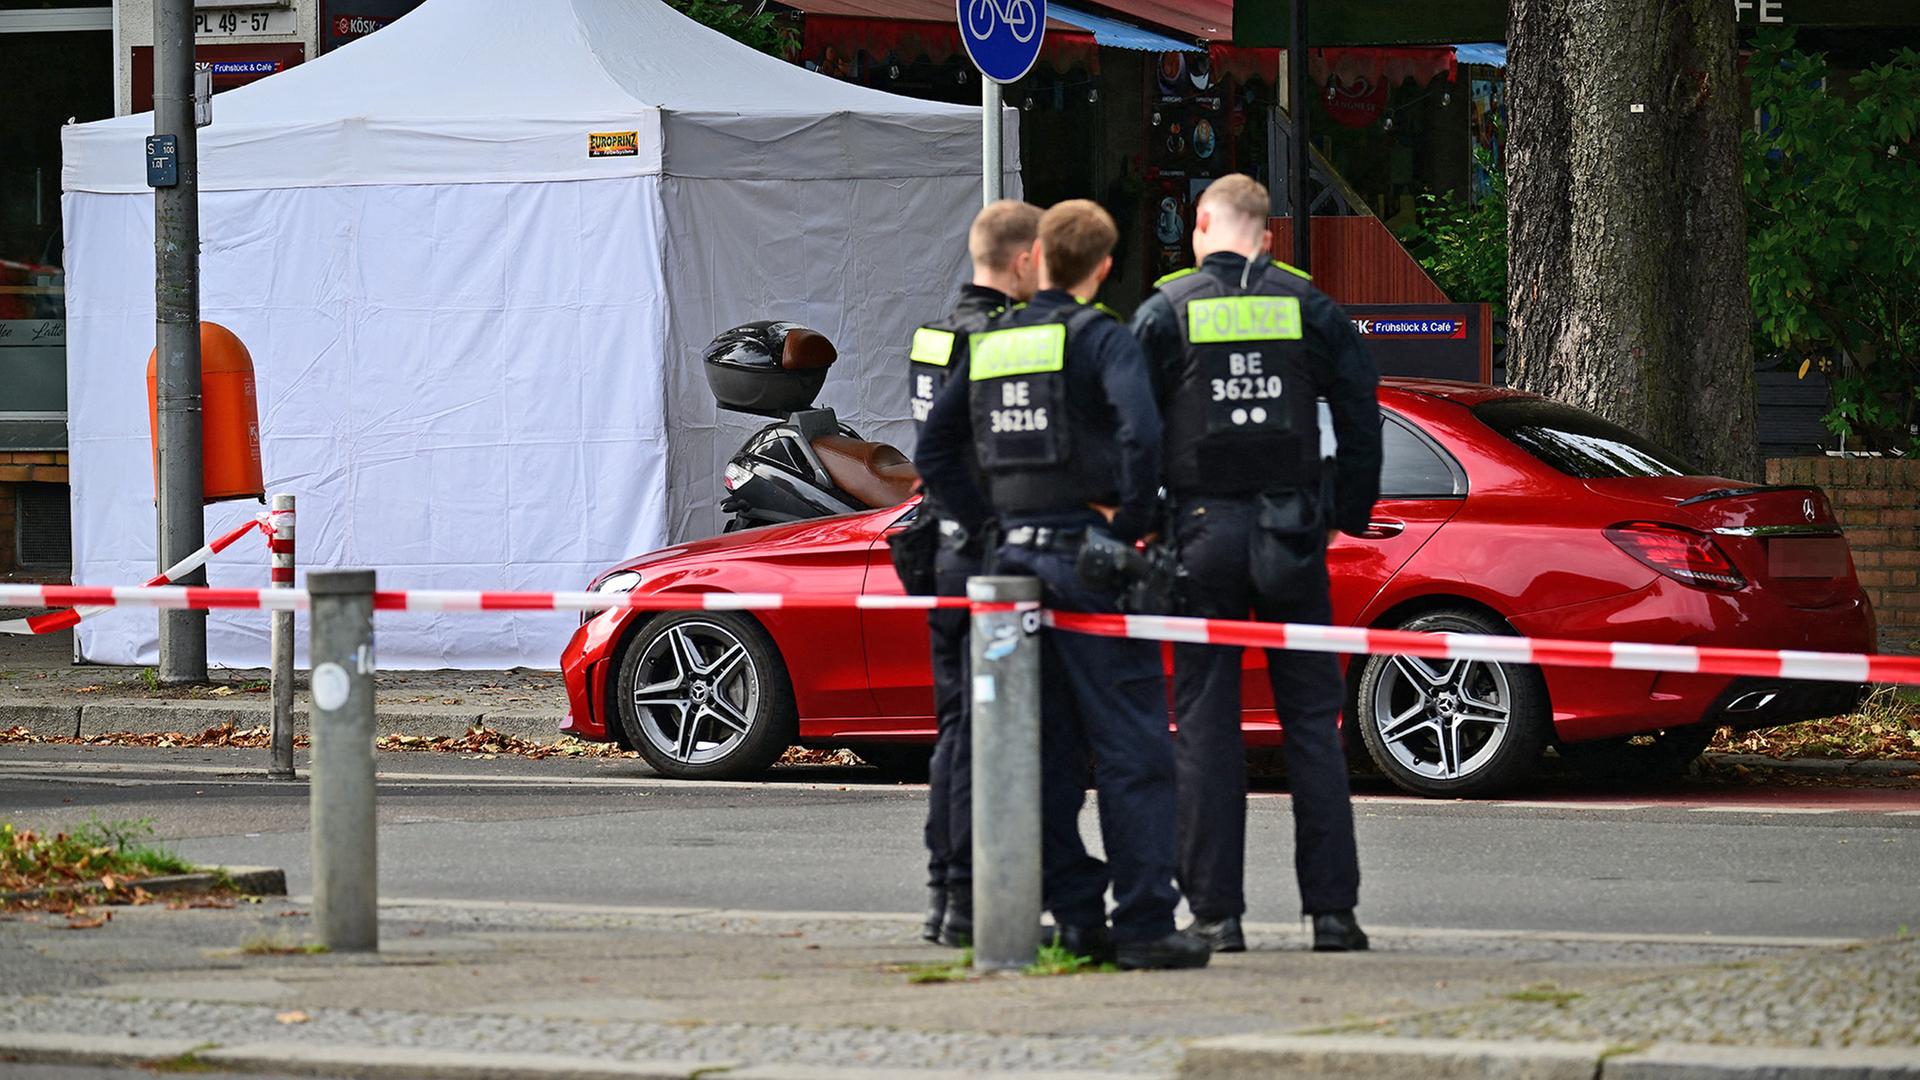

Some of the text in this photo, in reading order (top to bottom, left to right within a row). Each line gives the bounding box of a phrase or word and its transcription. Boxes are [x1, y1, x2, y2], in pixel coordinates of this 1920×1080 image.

[219, 13, 237, 32] 49
[251, 12, 269, 31] 57
[350, 16, 376, 33] KÖSK
[214, 64, 248, 72] Frühstück
[147, 143, 175, 155] S 100
[590, 132, 637, 150] EUROPRINZ
[1375, 322, 1420, 332] Frühstück
[1421, 322, 1429, 332] &
[1430, 321, 1451, 332] Café
[1229, 352, 1263, 376] BE
[1002, 381, 1030, 407] BE
[1211, 375, 1282, 401] 36210
[990, 407, 1048, 433] 36216
